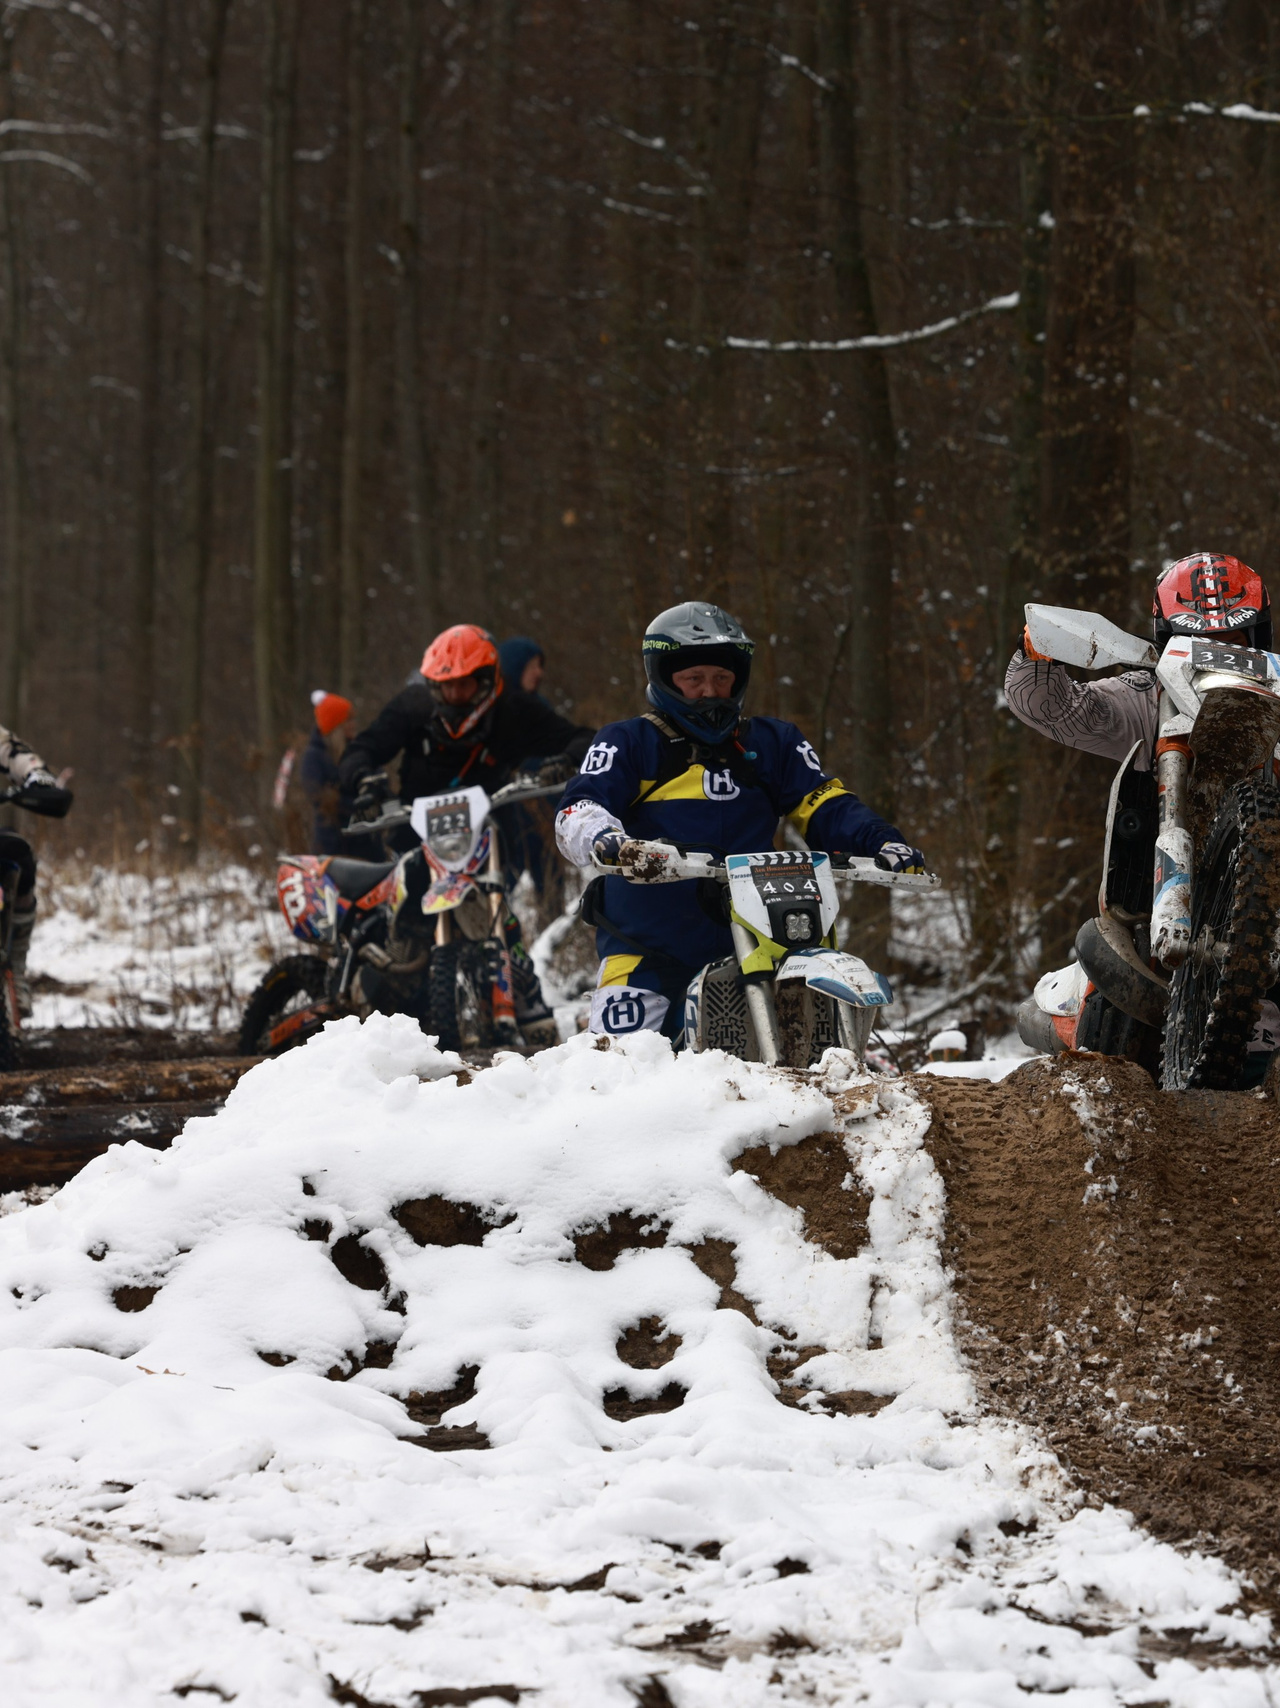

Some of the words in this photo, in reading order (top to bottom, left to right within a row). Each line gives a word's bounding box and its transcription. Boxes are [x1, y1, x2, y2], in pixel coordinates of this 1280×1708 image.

[1170, 614, 1202, 631] Airoh
[1227, 608, 1256, 628] Airoh
[1200, 651, 1255, 671] 321
[763, 879, 817, 894] 404
[787, 963, 808, 972] SCOTT
